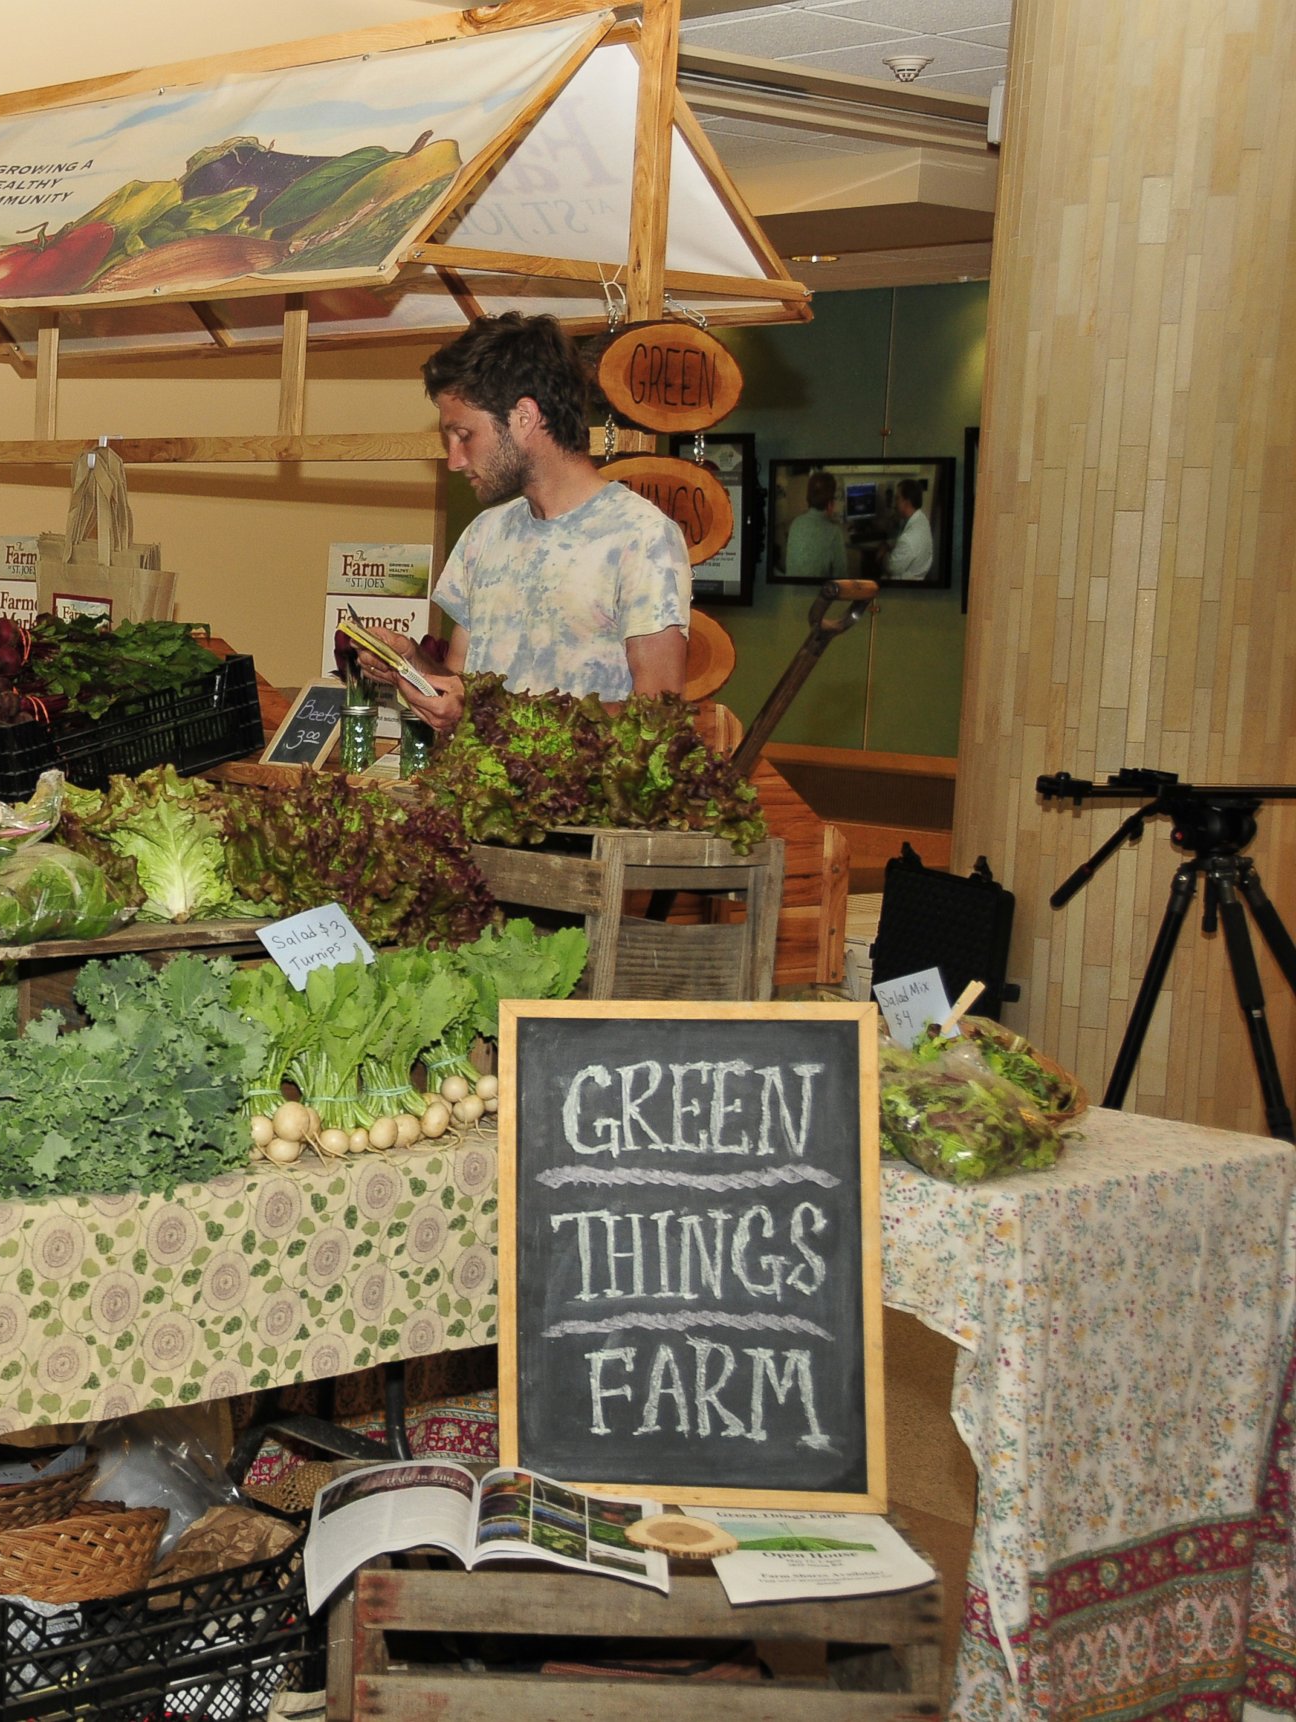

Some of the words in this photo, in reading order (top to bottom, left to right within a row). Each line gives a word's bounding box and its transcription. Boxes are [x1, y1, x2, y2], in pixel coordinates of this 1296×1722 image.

[80, 159, 95, 171] A
[630, 343, 716, 409] GREEN
[5, 545, 38, 565] Farm
[341, 554, 386, 577] Farm
[0, 591, 38, 611] Farm
[296, 699, 341, 725] Beets
[271, 924, 317, 950] Salad
[318, 920, 347, 939] $3
[288, 942, 342, 971] Turnips
[878, 986, 910, 1008] Salad
[909, 981, 930, 996] Mix
[561, 1058, 825, 1158] GREEN
[550, 1202, 829, 1302] THINGS
[584, 1333, 834, 1450] FARM
[716, 1511, 757, 1519] Green
[763, 1512, 806, 1520] Things
[762, 1551, 805, 1560] Open
[809, 1551, 859, 1560] House
